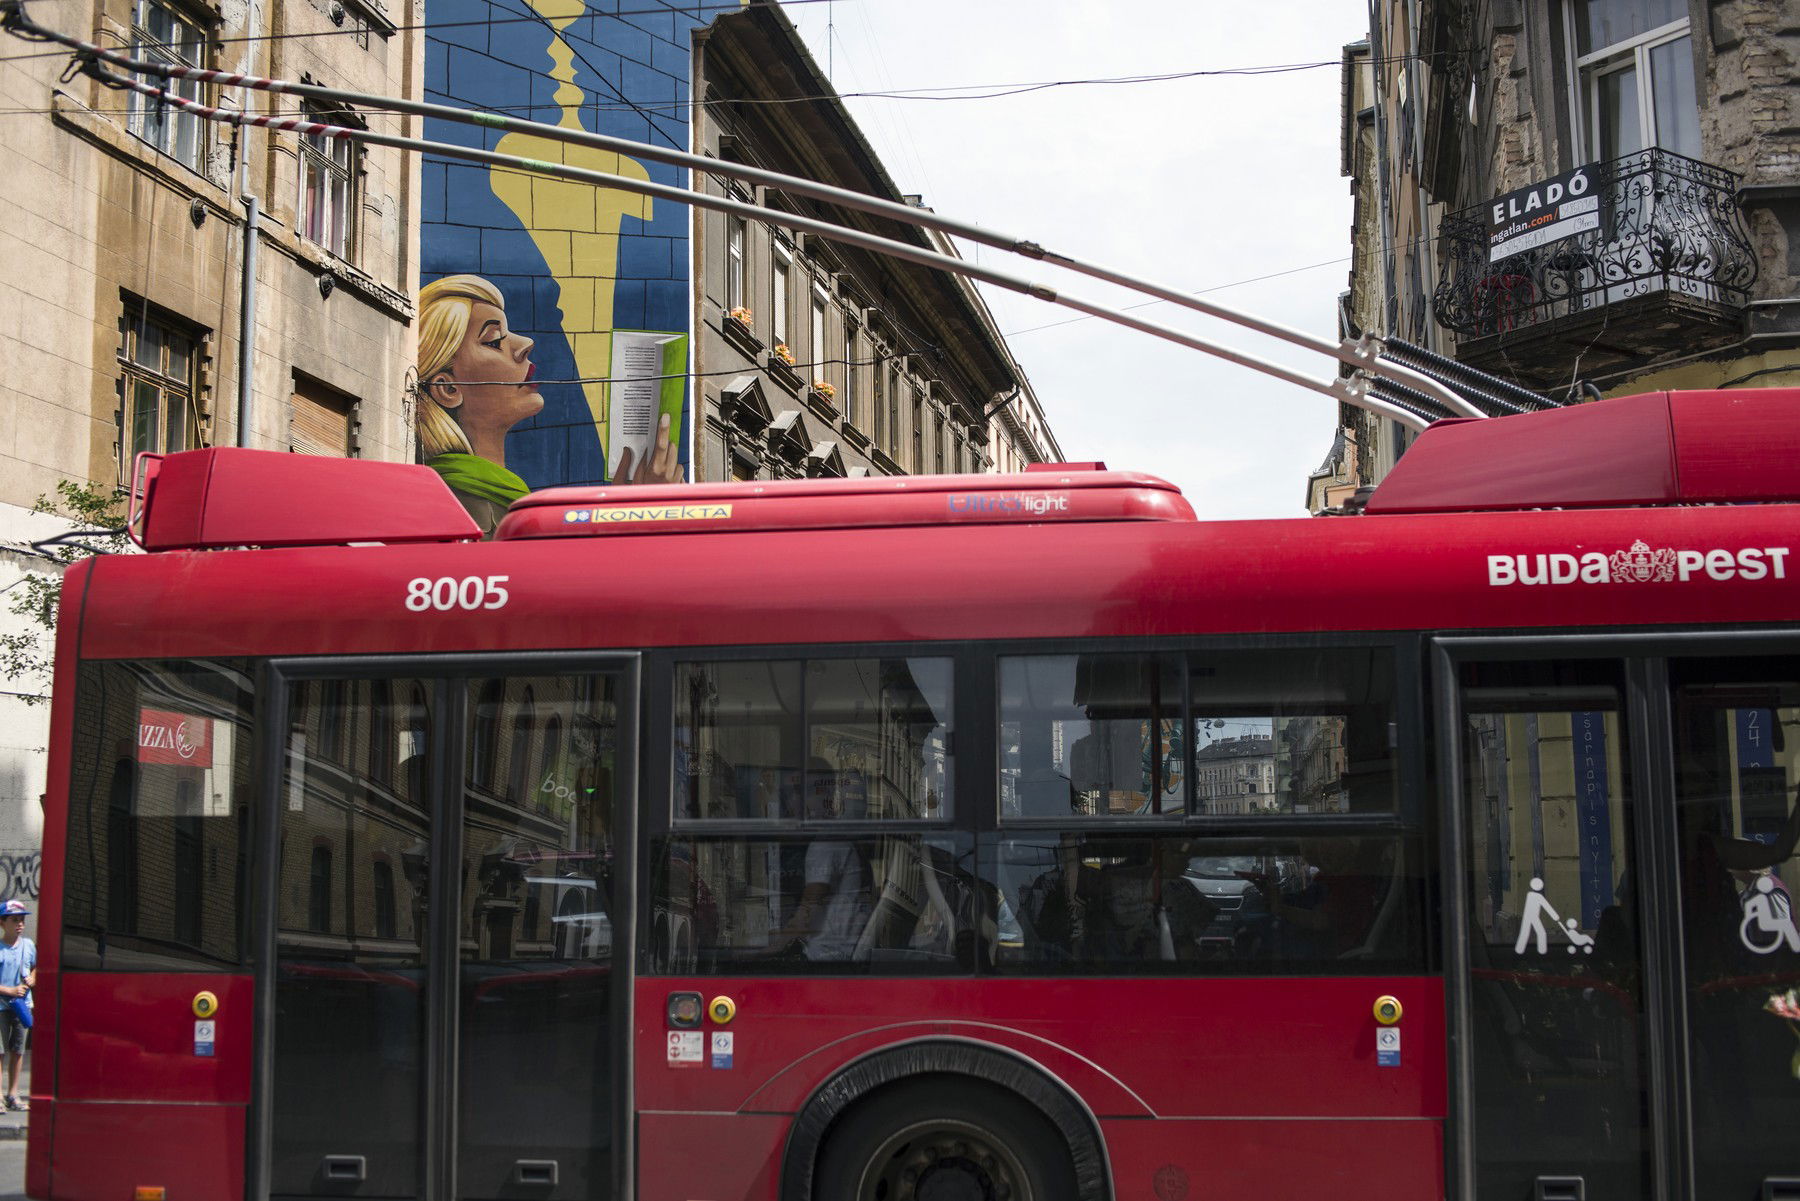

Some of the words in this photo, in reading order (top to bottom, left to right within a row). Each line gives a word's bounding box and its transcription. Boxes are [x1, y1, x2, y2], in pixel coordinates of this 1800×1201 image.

[1493, 169, 1588, 225] ELADÓ
[595, 506, 728, 521] KONVEKTA
[405, 575, 509, 612] 8005
[138, 724, 175, 749] IZZA
